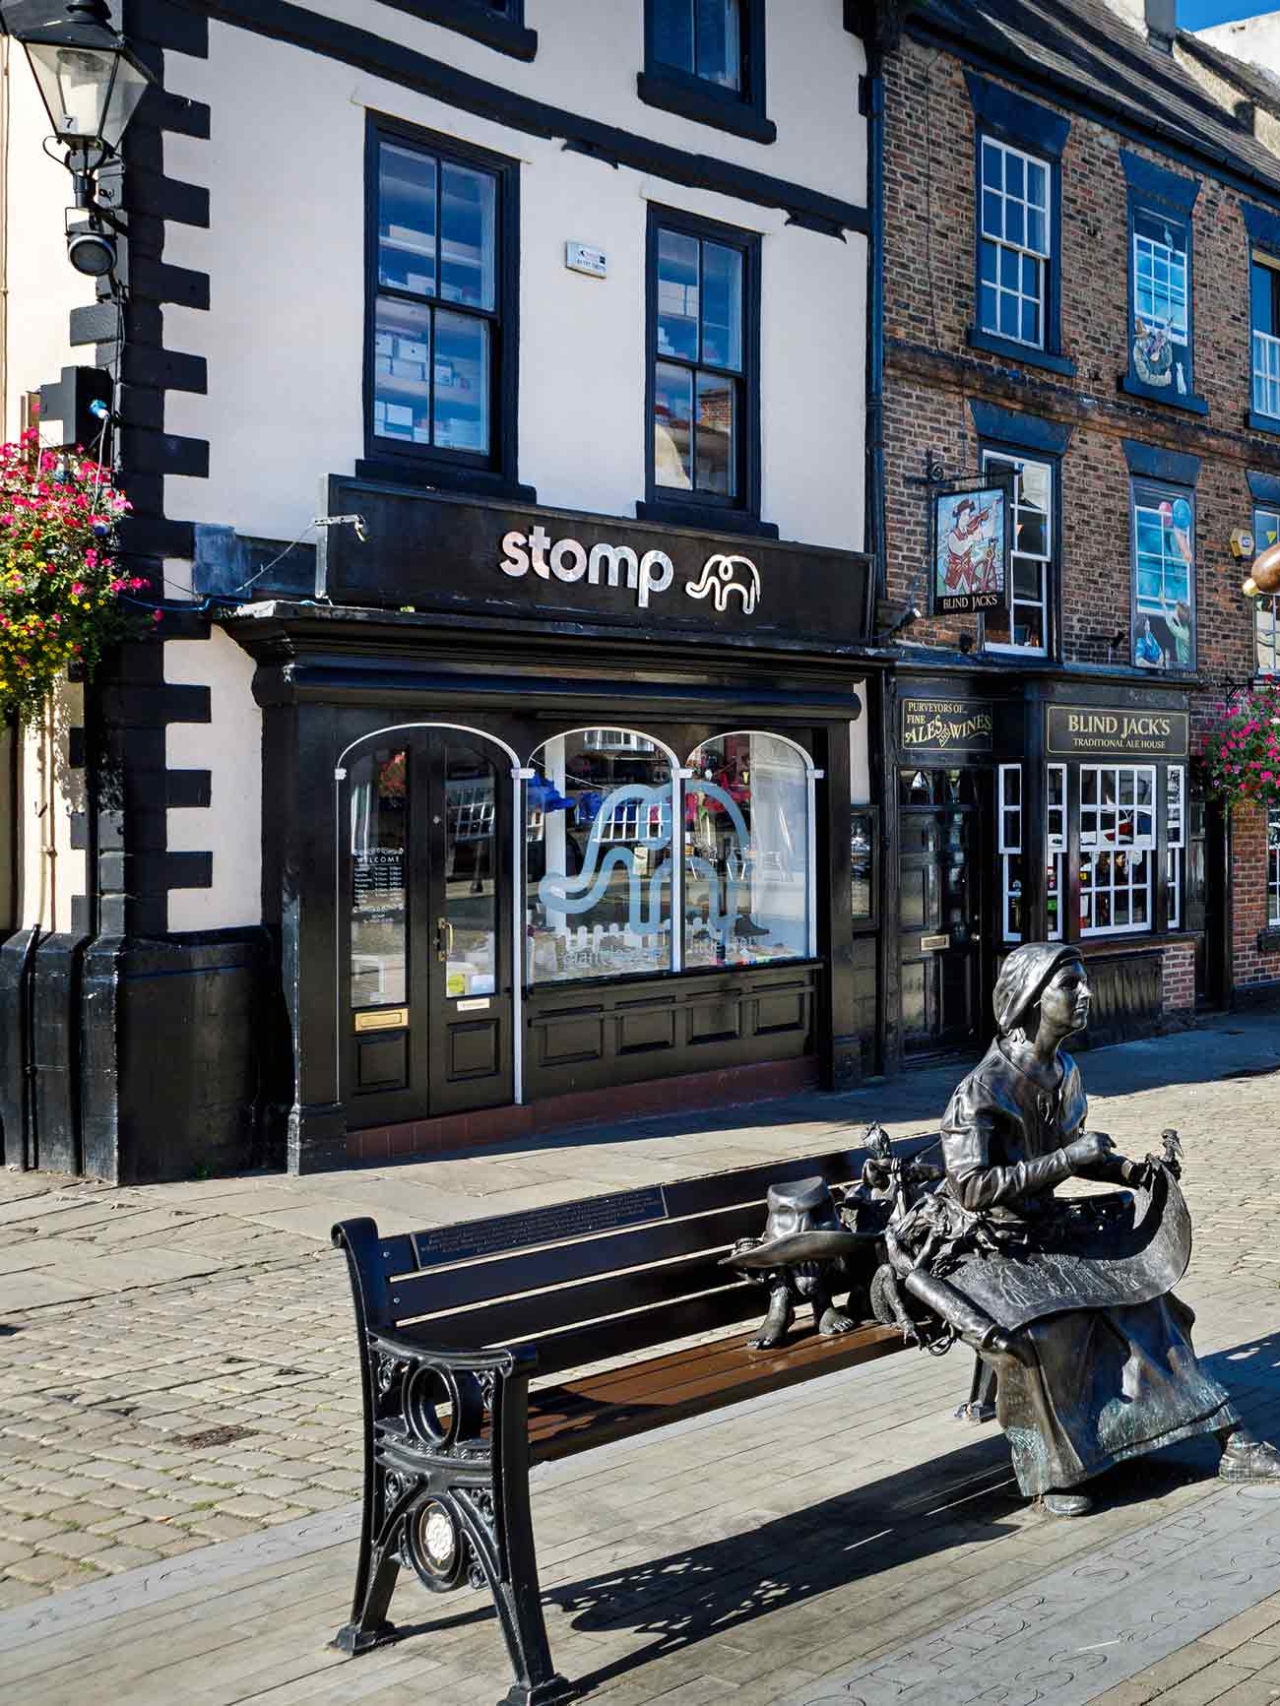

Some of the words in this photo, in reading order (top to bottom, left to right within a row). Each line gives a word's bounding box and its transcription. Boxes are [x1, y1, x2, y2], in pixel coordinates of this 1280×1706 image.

[499, 525, 675, 608] stomp
[943, 596, 969, 610] BLIND
[908, 702, 952, 713] PURVEYORS
[906, 714, 927, 725] FINE
[1067, 714, 1118, 734] BLIND
[1120, 717, 1171, 739] JACK'S
[904, 714, 944, 744] ALES
[947, 714, 992, 740] WINES
[1072, 737, 1124, 748] TRADITIONAL
[1125, 740, 1140, 749] ALE
[1141, 740, 1166, 749] HOUSE
